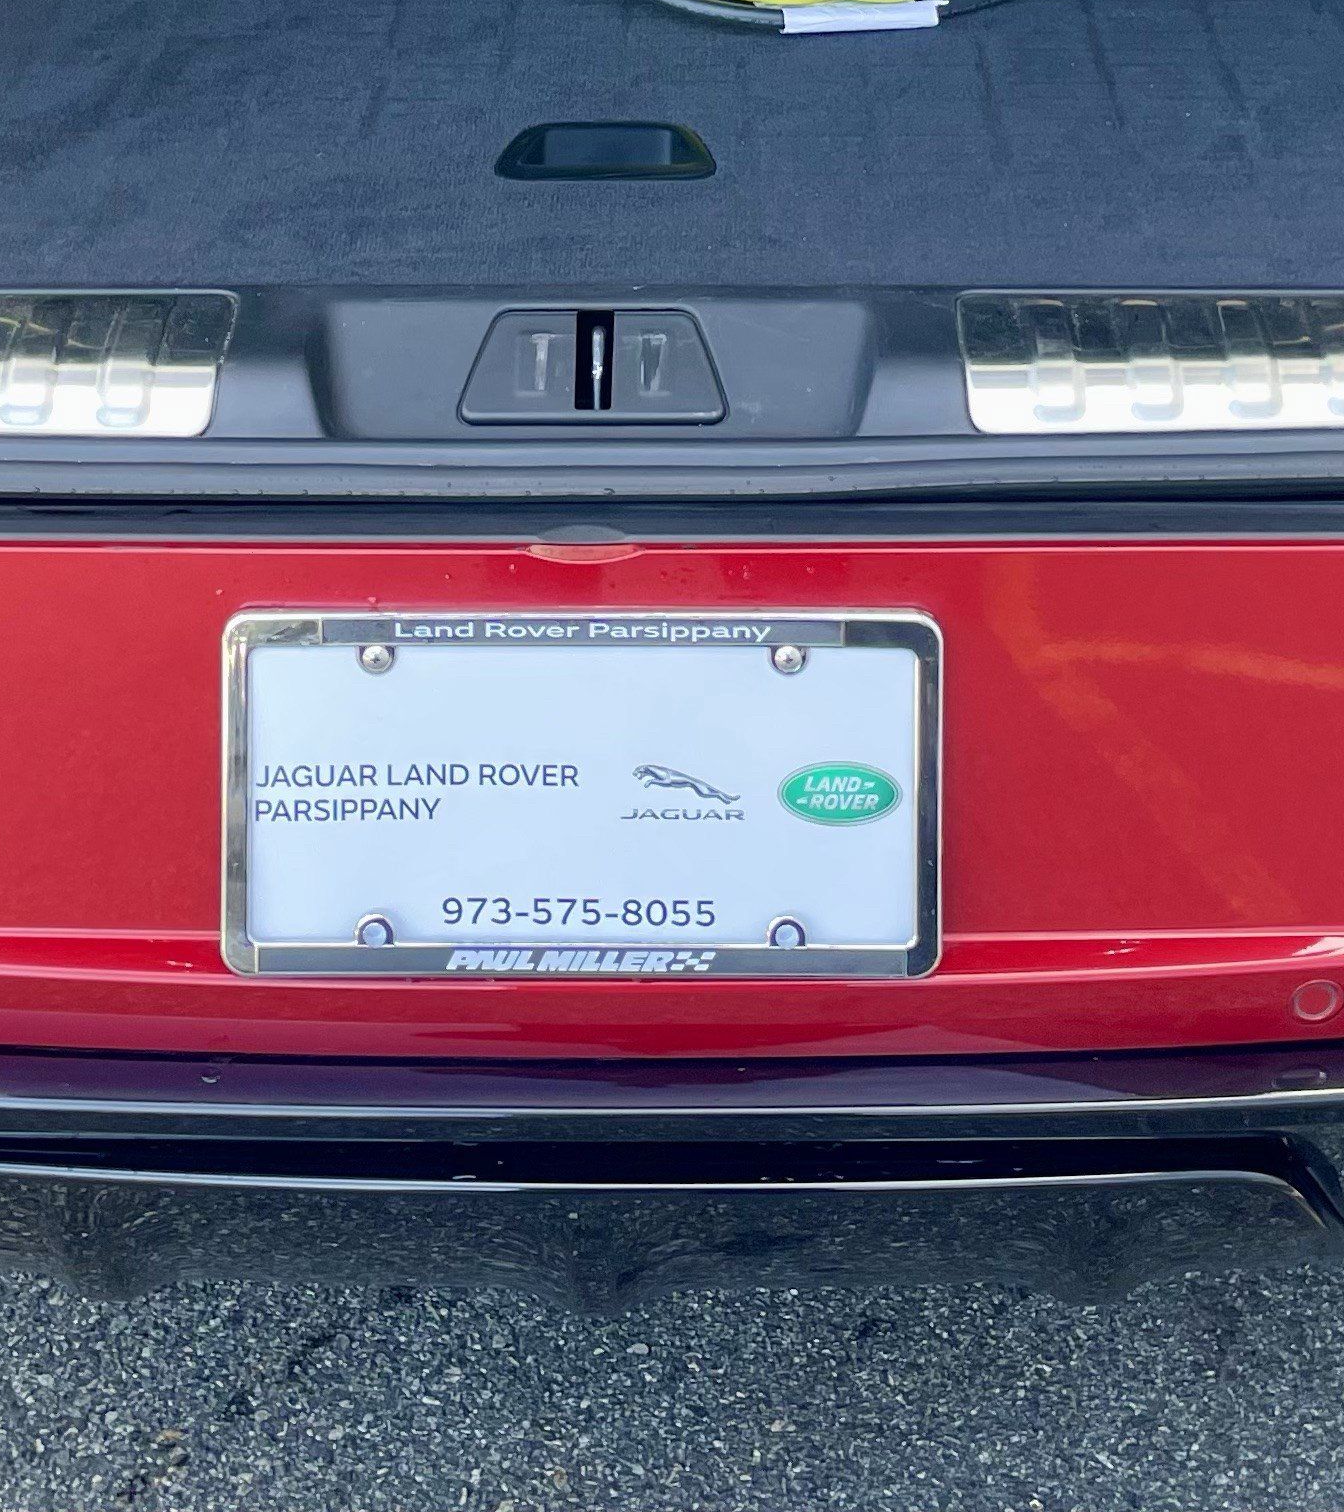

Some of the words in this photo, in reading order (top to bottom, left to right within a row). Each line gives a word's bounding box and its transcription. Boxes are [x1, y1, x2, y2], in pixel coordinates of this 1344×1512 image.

[394, 621, 474, 639] Land
[484, 621, 580, 639] Rover
[588, 621, 771, 643] Parsippany
[255, 763, 378, 788] JAGUAR
[386, 763, 470, 787] LAND
[478, 763, 580, 787] ROVER
[254, 797, 442, 823] PARSIPPANY
[620, 808, 746, 821] JAGUAR
[441, 896, 716, 927] 973-575-8055
[445, 949, 534, 971] PAUL
[536, 950, 676, 972] MILLER
